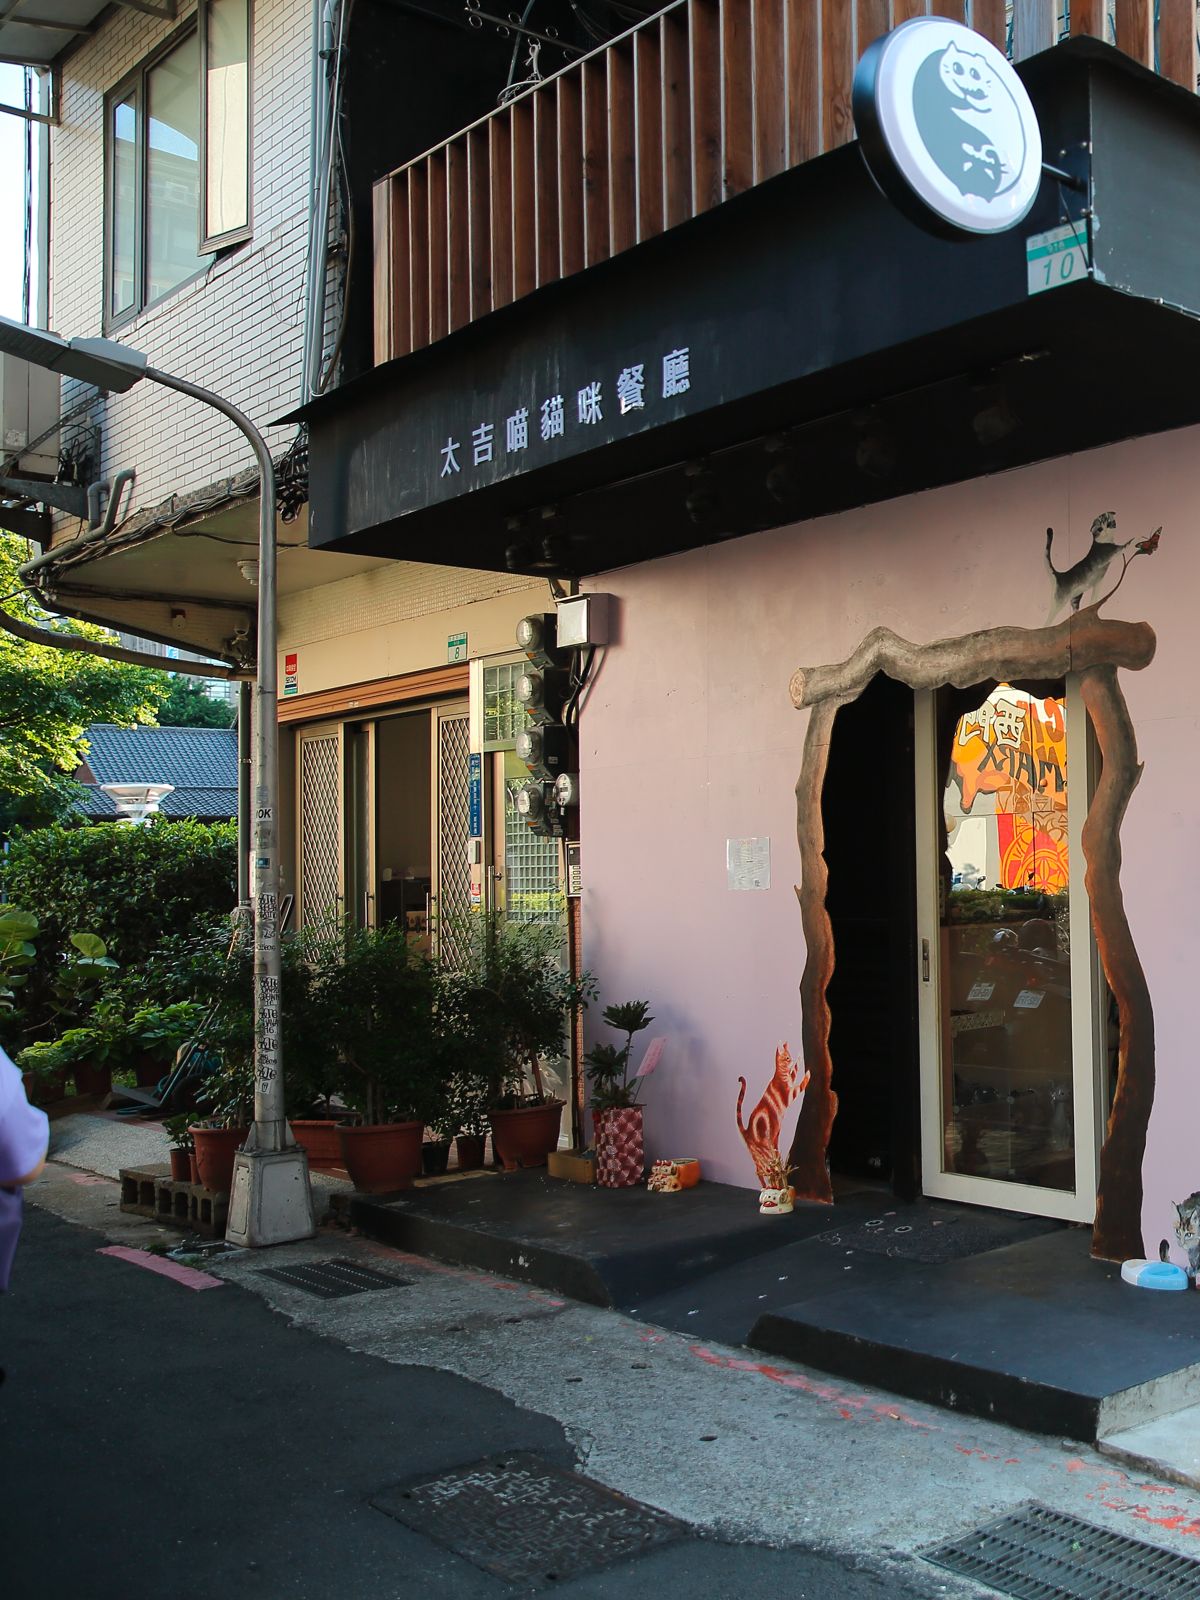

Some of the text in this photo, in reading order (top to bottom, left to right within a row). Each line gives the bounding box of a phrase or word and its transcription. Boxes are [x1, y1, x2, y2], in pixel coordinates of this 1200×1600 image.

[1044, 252, 1074, 286] 10
[440, 347, 691, 478] 太吉喵貓咪餐廳
[455, 646, 460, 659] 8
